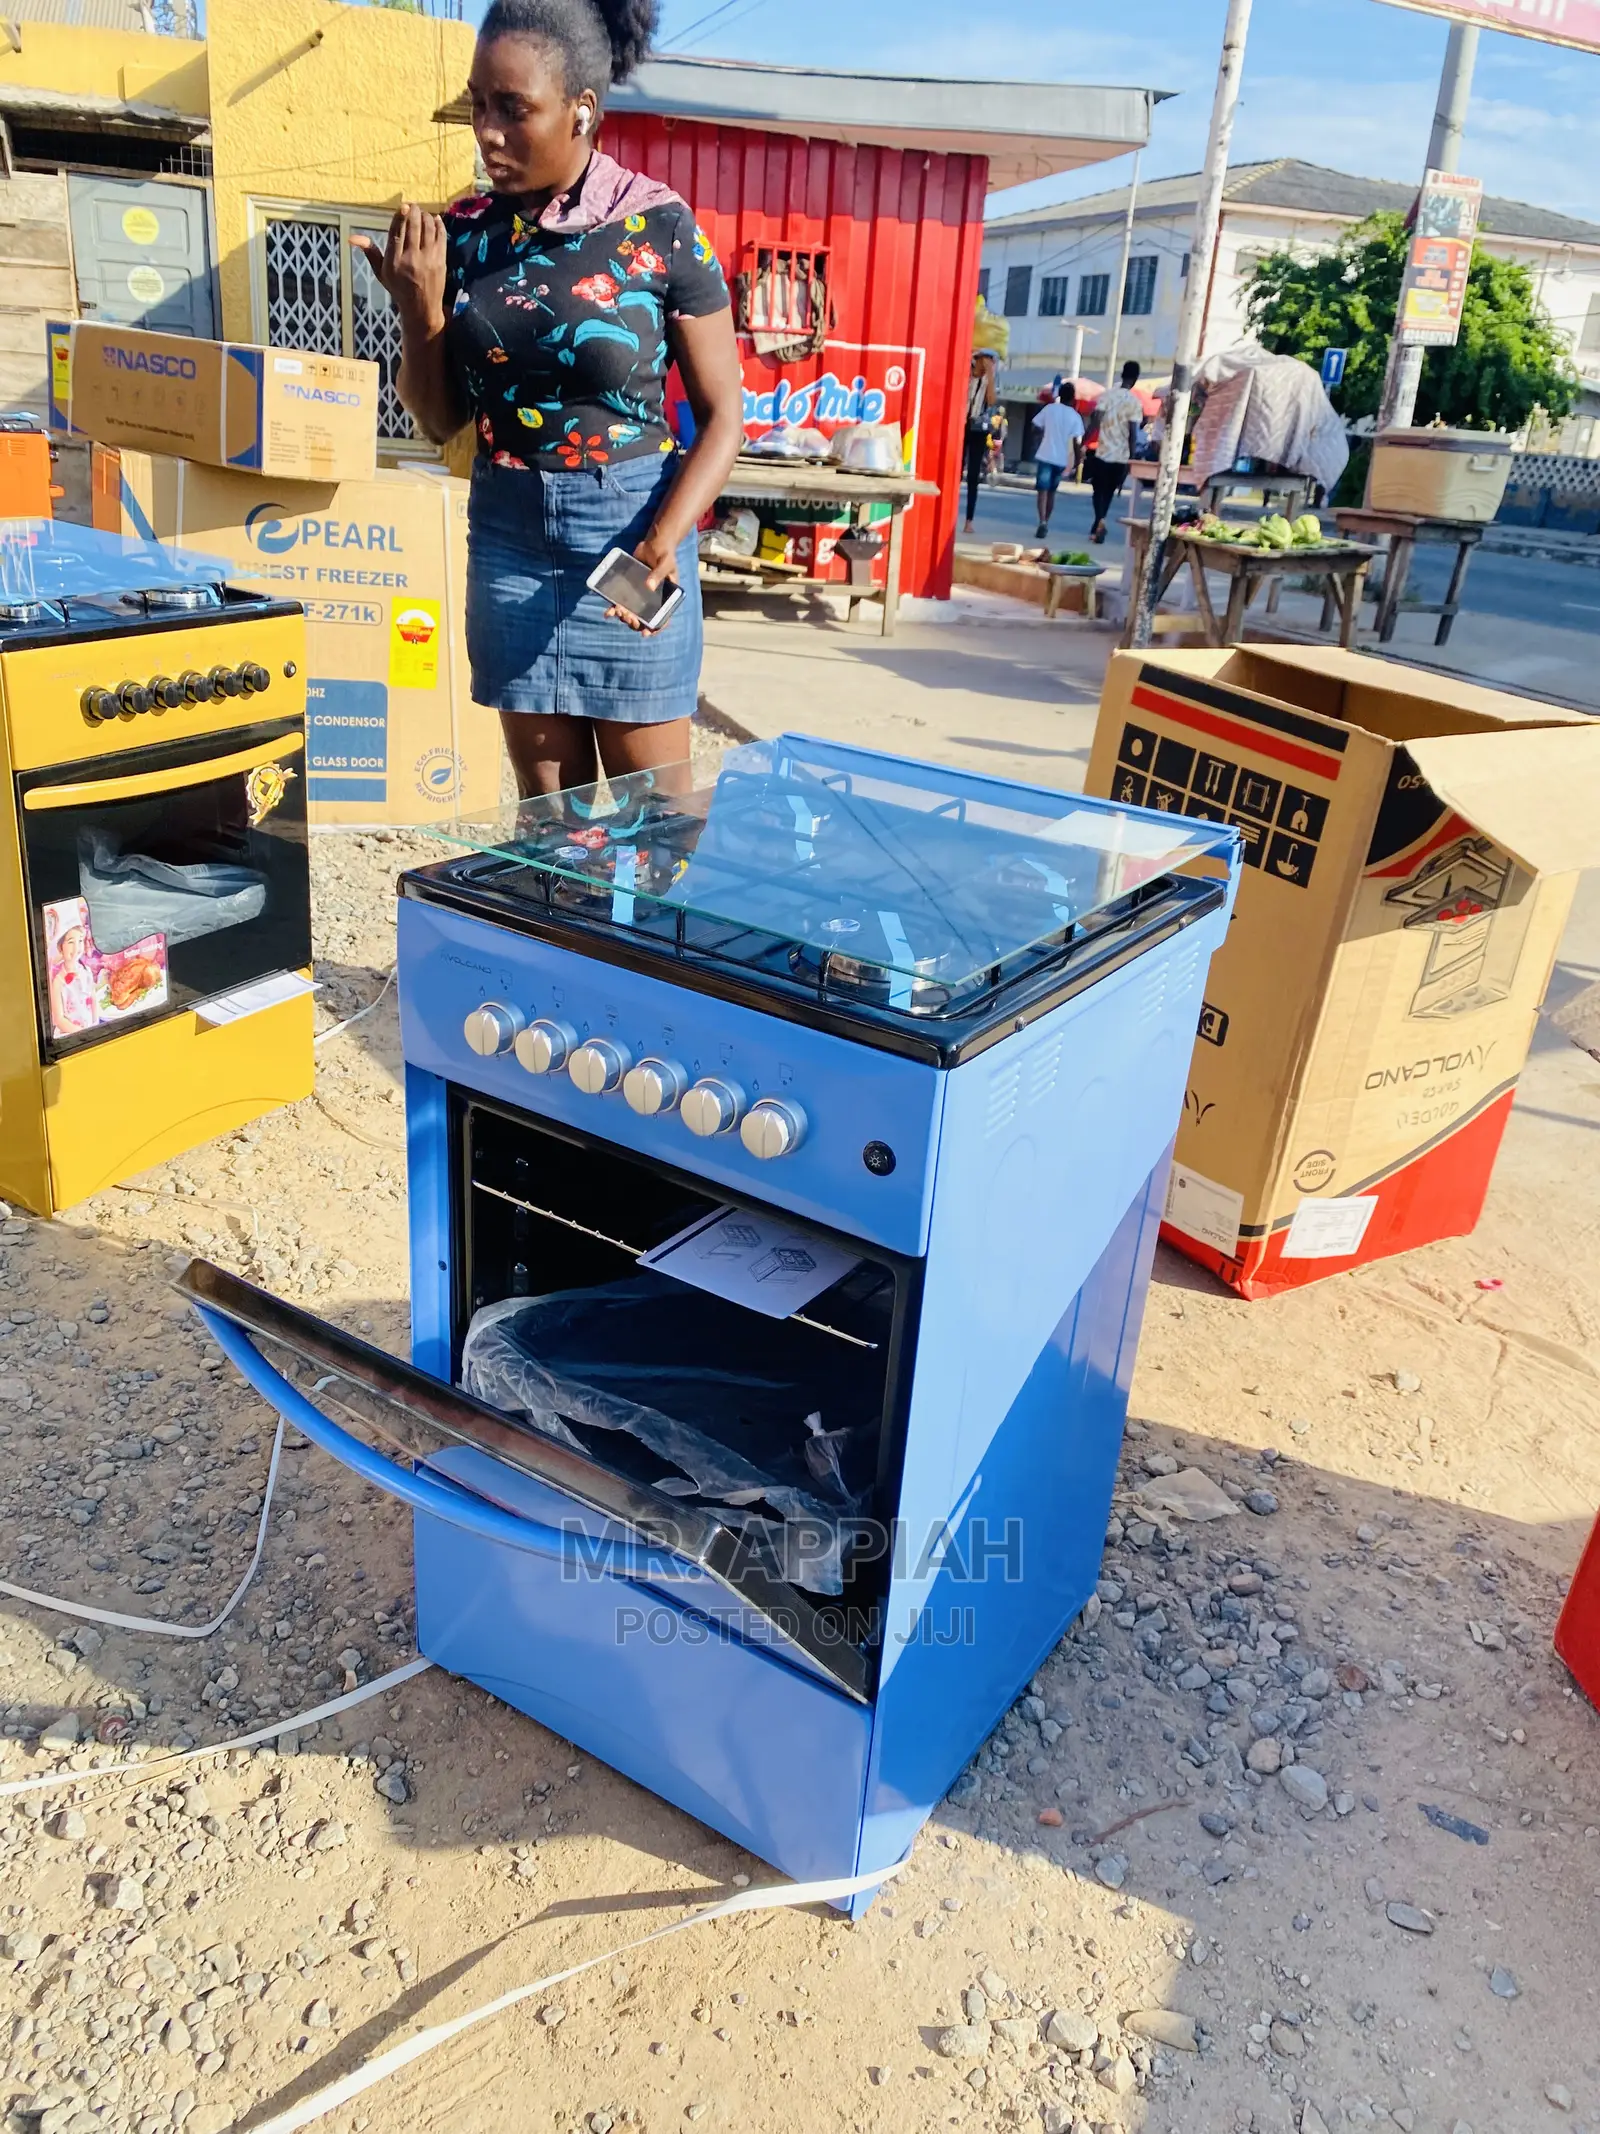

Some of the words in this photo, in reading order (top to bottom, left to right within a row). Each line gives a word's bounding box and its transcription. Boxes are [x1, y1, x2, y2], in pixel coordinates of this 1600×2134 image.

[115, 348, 197, 380] NASCO
[296, 385, 361, 407] NASCO
[302, 518, 404, 553] PEARL
[316, 567, 409, 588] FREEZER
[304, 602, 376, 623] F-271k
[314, 715, 386, 728] CONDENSOR
[312, 756, 348, 768] GLASS
[351, 757, 384, 768] DOOR
[414, 747, 468, 772] ECO-FRIELY
[415, 782, 466, 803] REFRIGERT
[1365, 1052, 1475, 1090] VOLCANO
[1300, 1168, 1329, 1179] FRONT
[1306, 1159, 1327, 1169] SIDE
